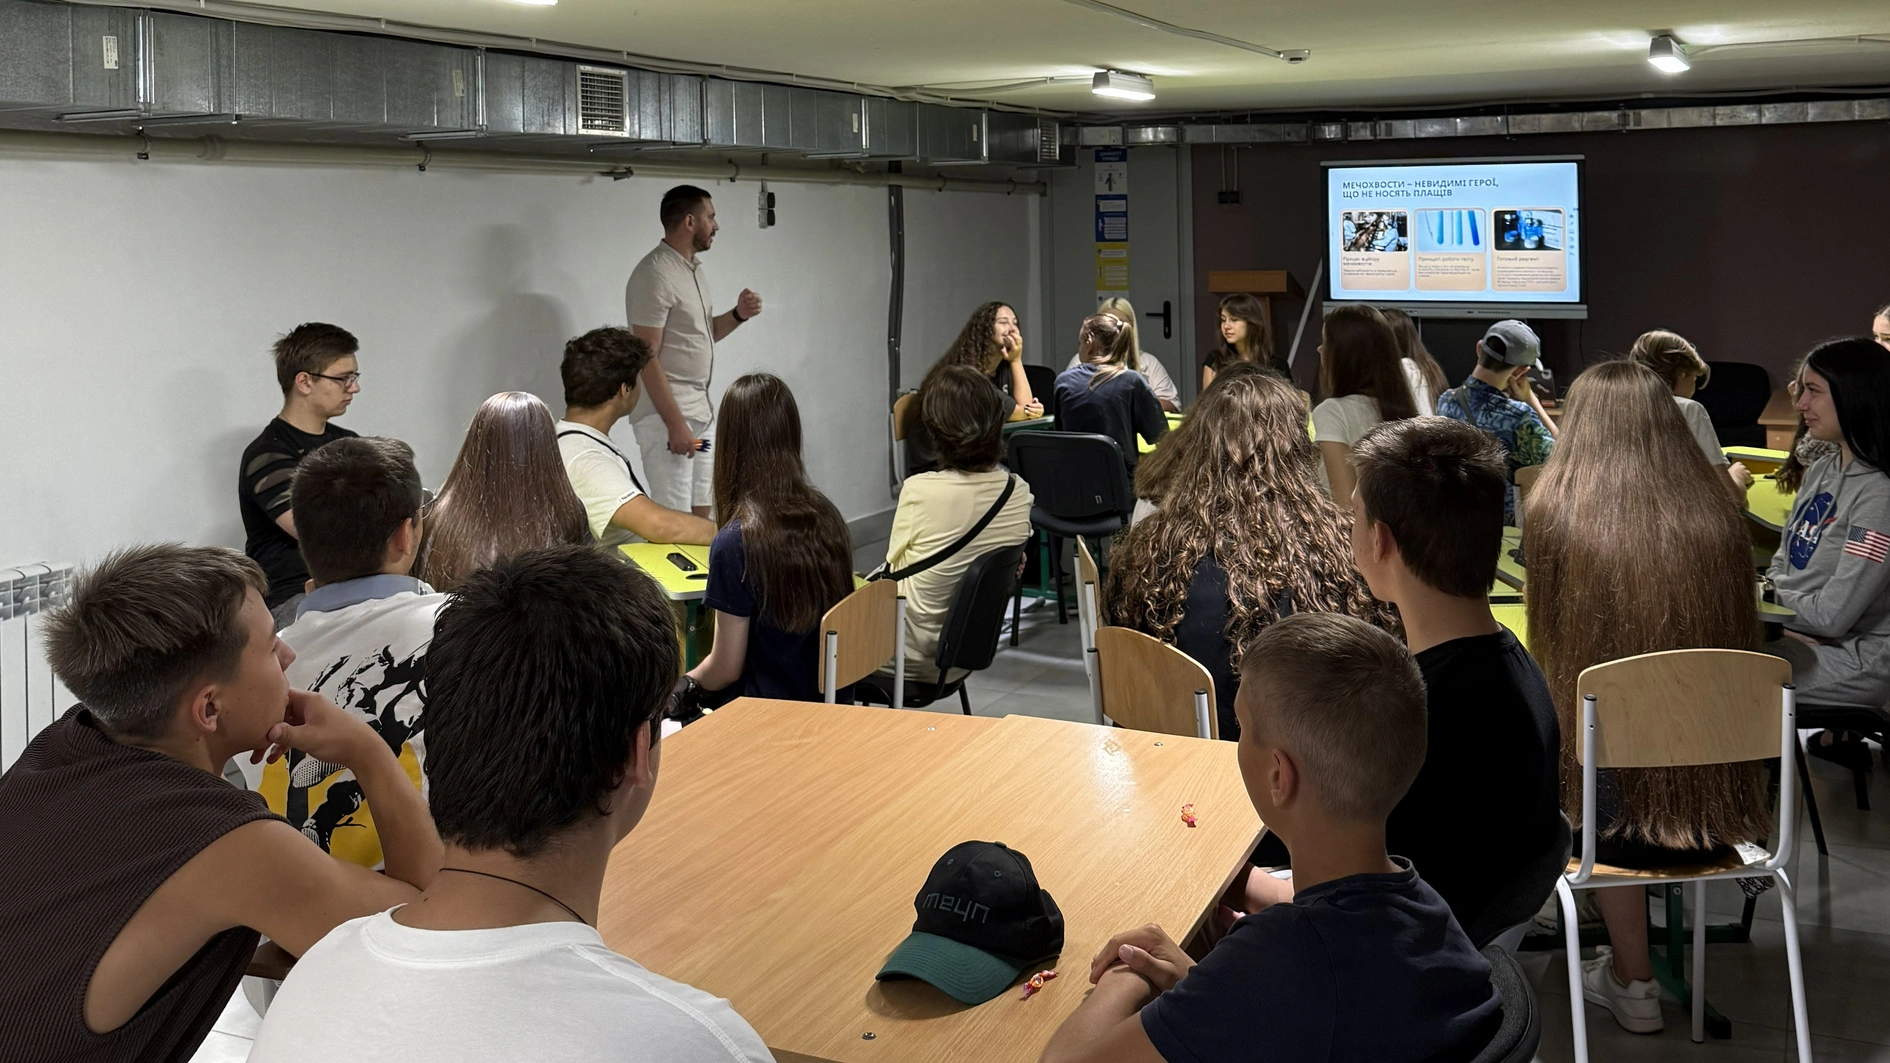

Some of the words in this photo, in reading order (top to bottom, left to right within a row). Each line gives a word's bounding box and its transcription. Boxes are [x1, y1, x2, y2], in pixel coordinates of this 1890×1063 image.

[1342, 180, 1405, 189] МЕЧОХВОСТИ
[1414, 179, 1466, 189] НЕВИДИМІ
[1468, 177, 1499, 187] ГЕРОЇ,
[1342, 190, 1359, 199] ЩО
[1361, 190, 1373, 198] НЕ
[1375, 189, 1411, 198] НОСЯТЬ
[1413, 189, 1453, 198] ПЛАЩІВ
